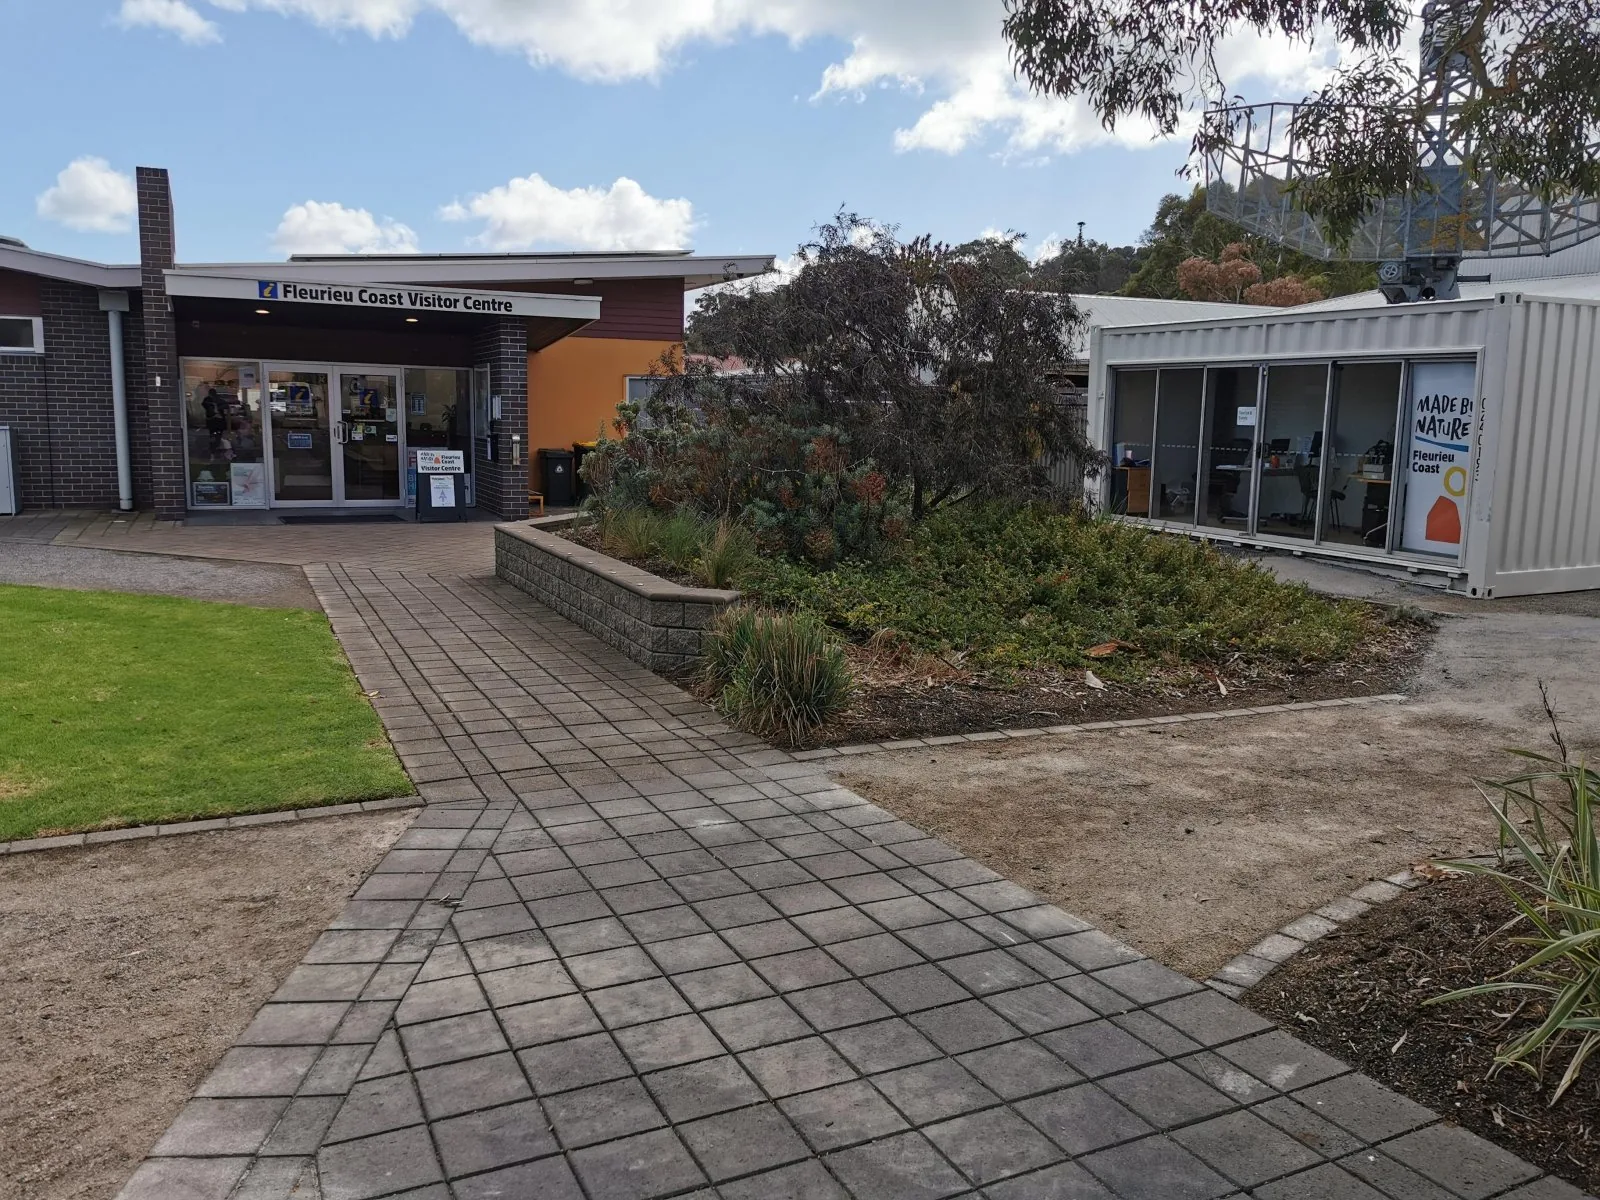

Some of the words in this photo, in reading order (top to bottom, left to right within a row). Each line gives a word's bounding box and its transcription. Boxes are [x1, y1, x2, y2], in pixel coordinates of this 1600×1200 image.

[283, 284, 354, 302] Fleurieu
[358, 289, 404, 306] Coast
[407, 292, 460, 309] Visitor
[463, 296, 513, 312] Centre
[1417, 394, 1458, 414] MADE
[1415, 415, 1472, 441] NATURE
[1413, 450, 1455, 463] Fleurieu
[1412, 462, 1440, 474] Coast
